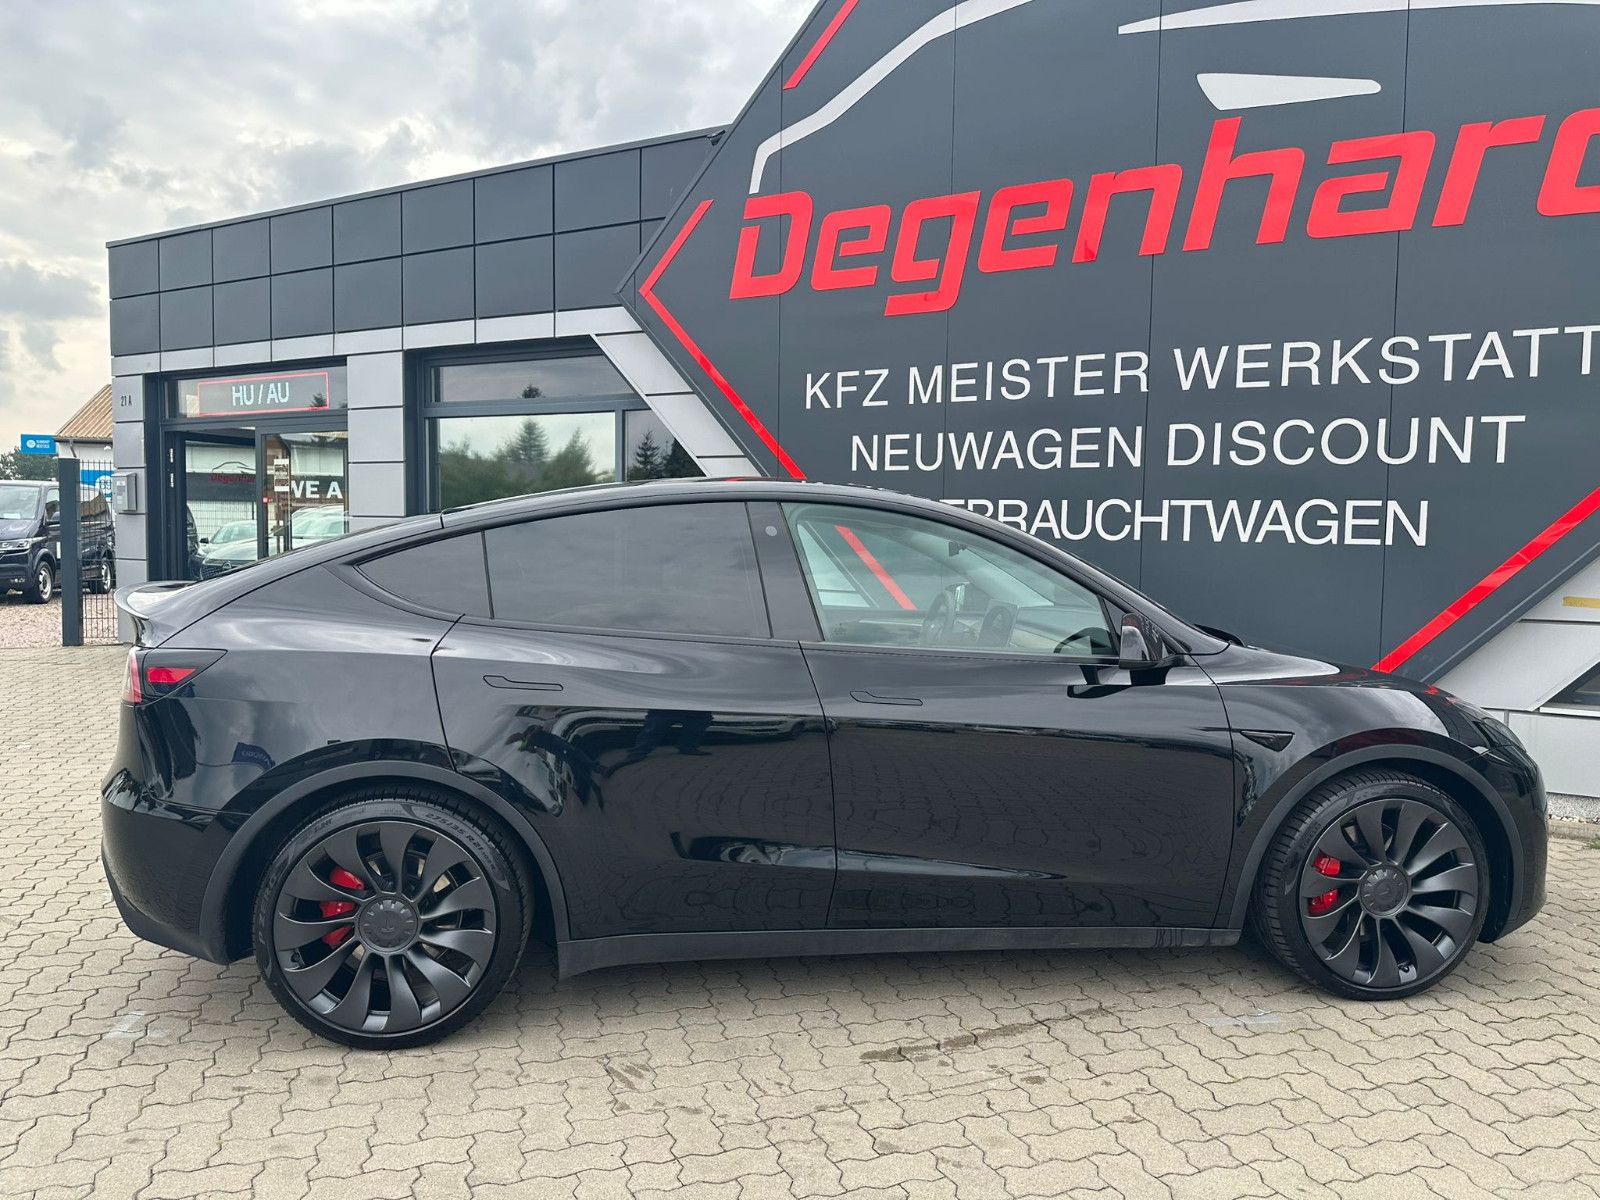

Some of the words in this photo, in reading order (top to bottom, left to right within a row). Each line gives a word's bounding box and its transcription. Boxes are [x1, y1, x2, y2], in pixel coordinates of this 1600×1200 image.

[805, 368, 889, 410] KFZ
[908, 351, 1149, 406] MEISTER
[1173, 325, 1600, 391] WERKSTATT
[851, 426, 1143, 471] NEUWAGEN
[1167, 415, 1526, 466] DISCOUNT
[938, 499, 1429, 547] RAUCHTWAGEN
